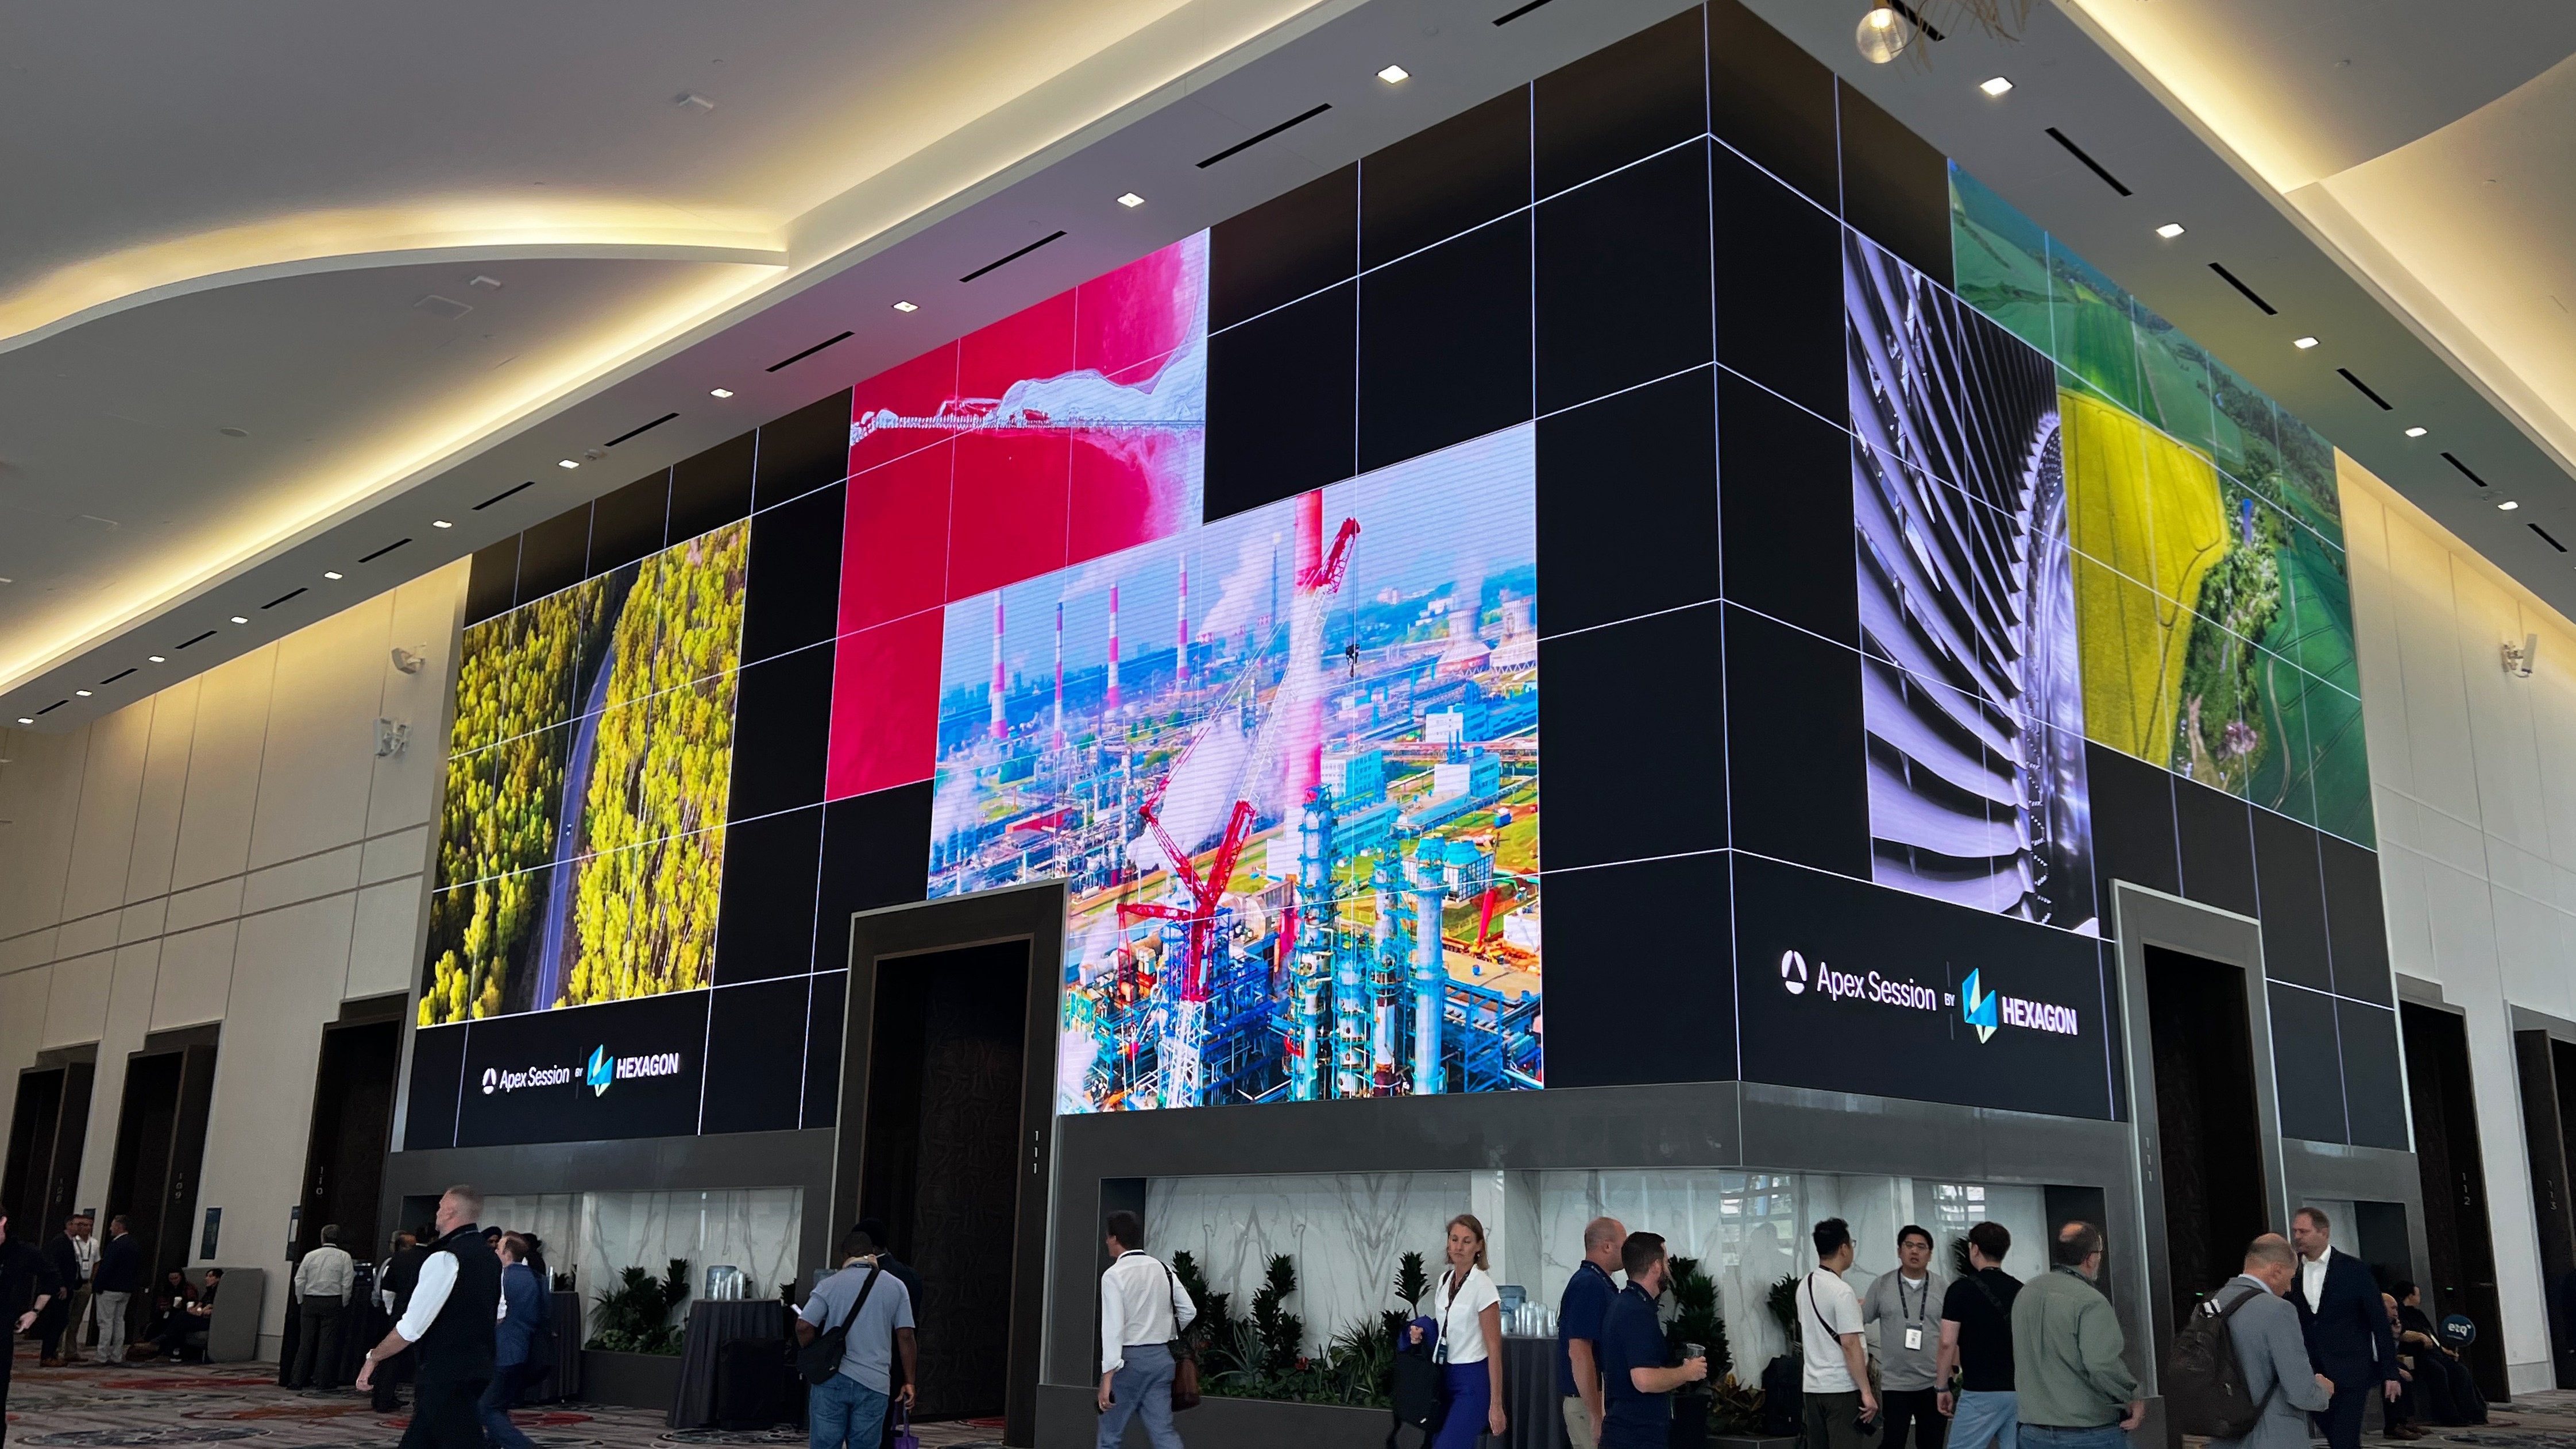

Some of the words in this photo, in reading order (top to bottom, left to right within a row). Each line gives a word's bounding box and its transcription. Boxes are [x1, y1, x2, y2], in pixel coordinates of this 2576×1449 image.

[1816, 961, 1866, 1002] Apex
[1868, 971, 1937, 1011] Session
[1944, 992, 1956, 1007] BY
[2002, 996, 2078, 1035] HEXAGON
[499, 1069, 527, 1092] Apex
[527, 1064, 570, 1087] Session
[574, 1067, 584, 1078] BY
[616, 1052, 679, 1079] HEXAGON
[2462, 1172, 2471, 1205] 112
